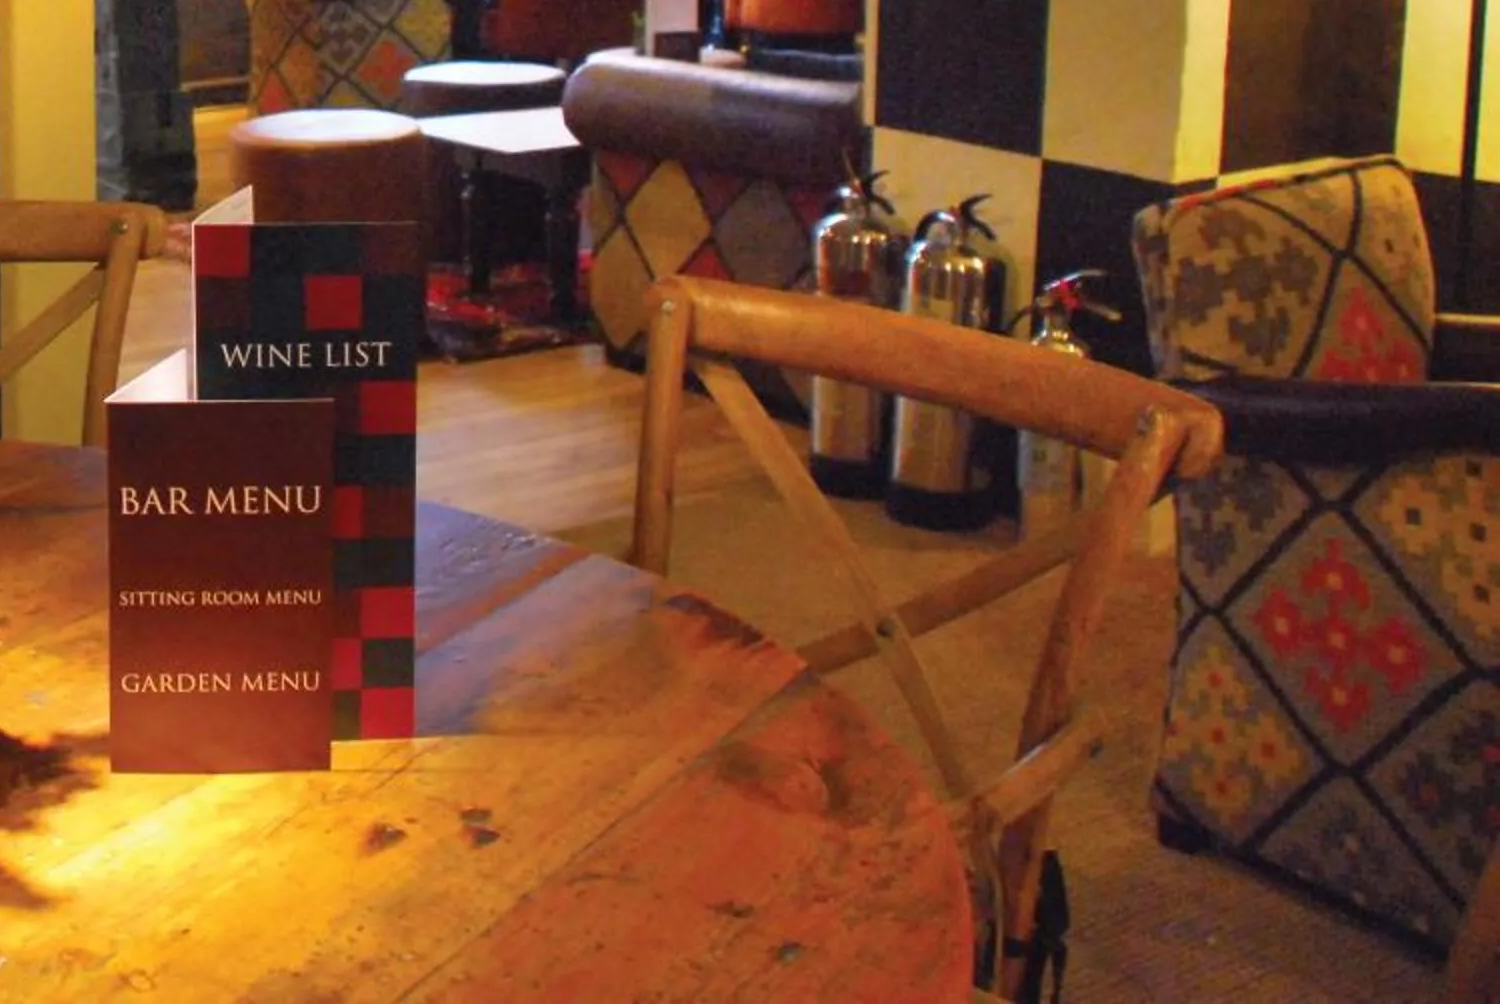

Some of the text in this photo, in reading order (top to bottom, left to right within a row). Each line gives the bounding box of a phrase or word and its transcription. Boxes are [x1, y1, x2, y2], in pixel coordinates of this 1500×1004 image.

[221, 340, 393, 369] WINE LIST
[120, 485, 322, 515] BAR MENU
[119, 590, 322, 606] SITTING ROOM MENU
[121, 670, 321, 694] GARDEN MENU
